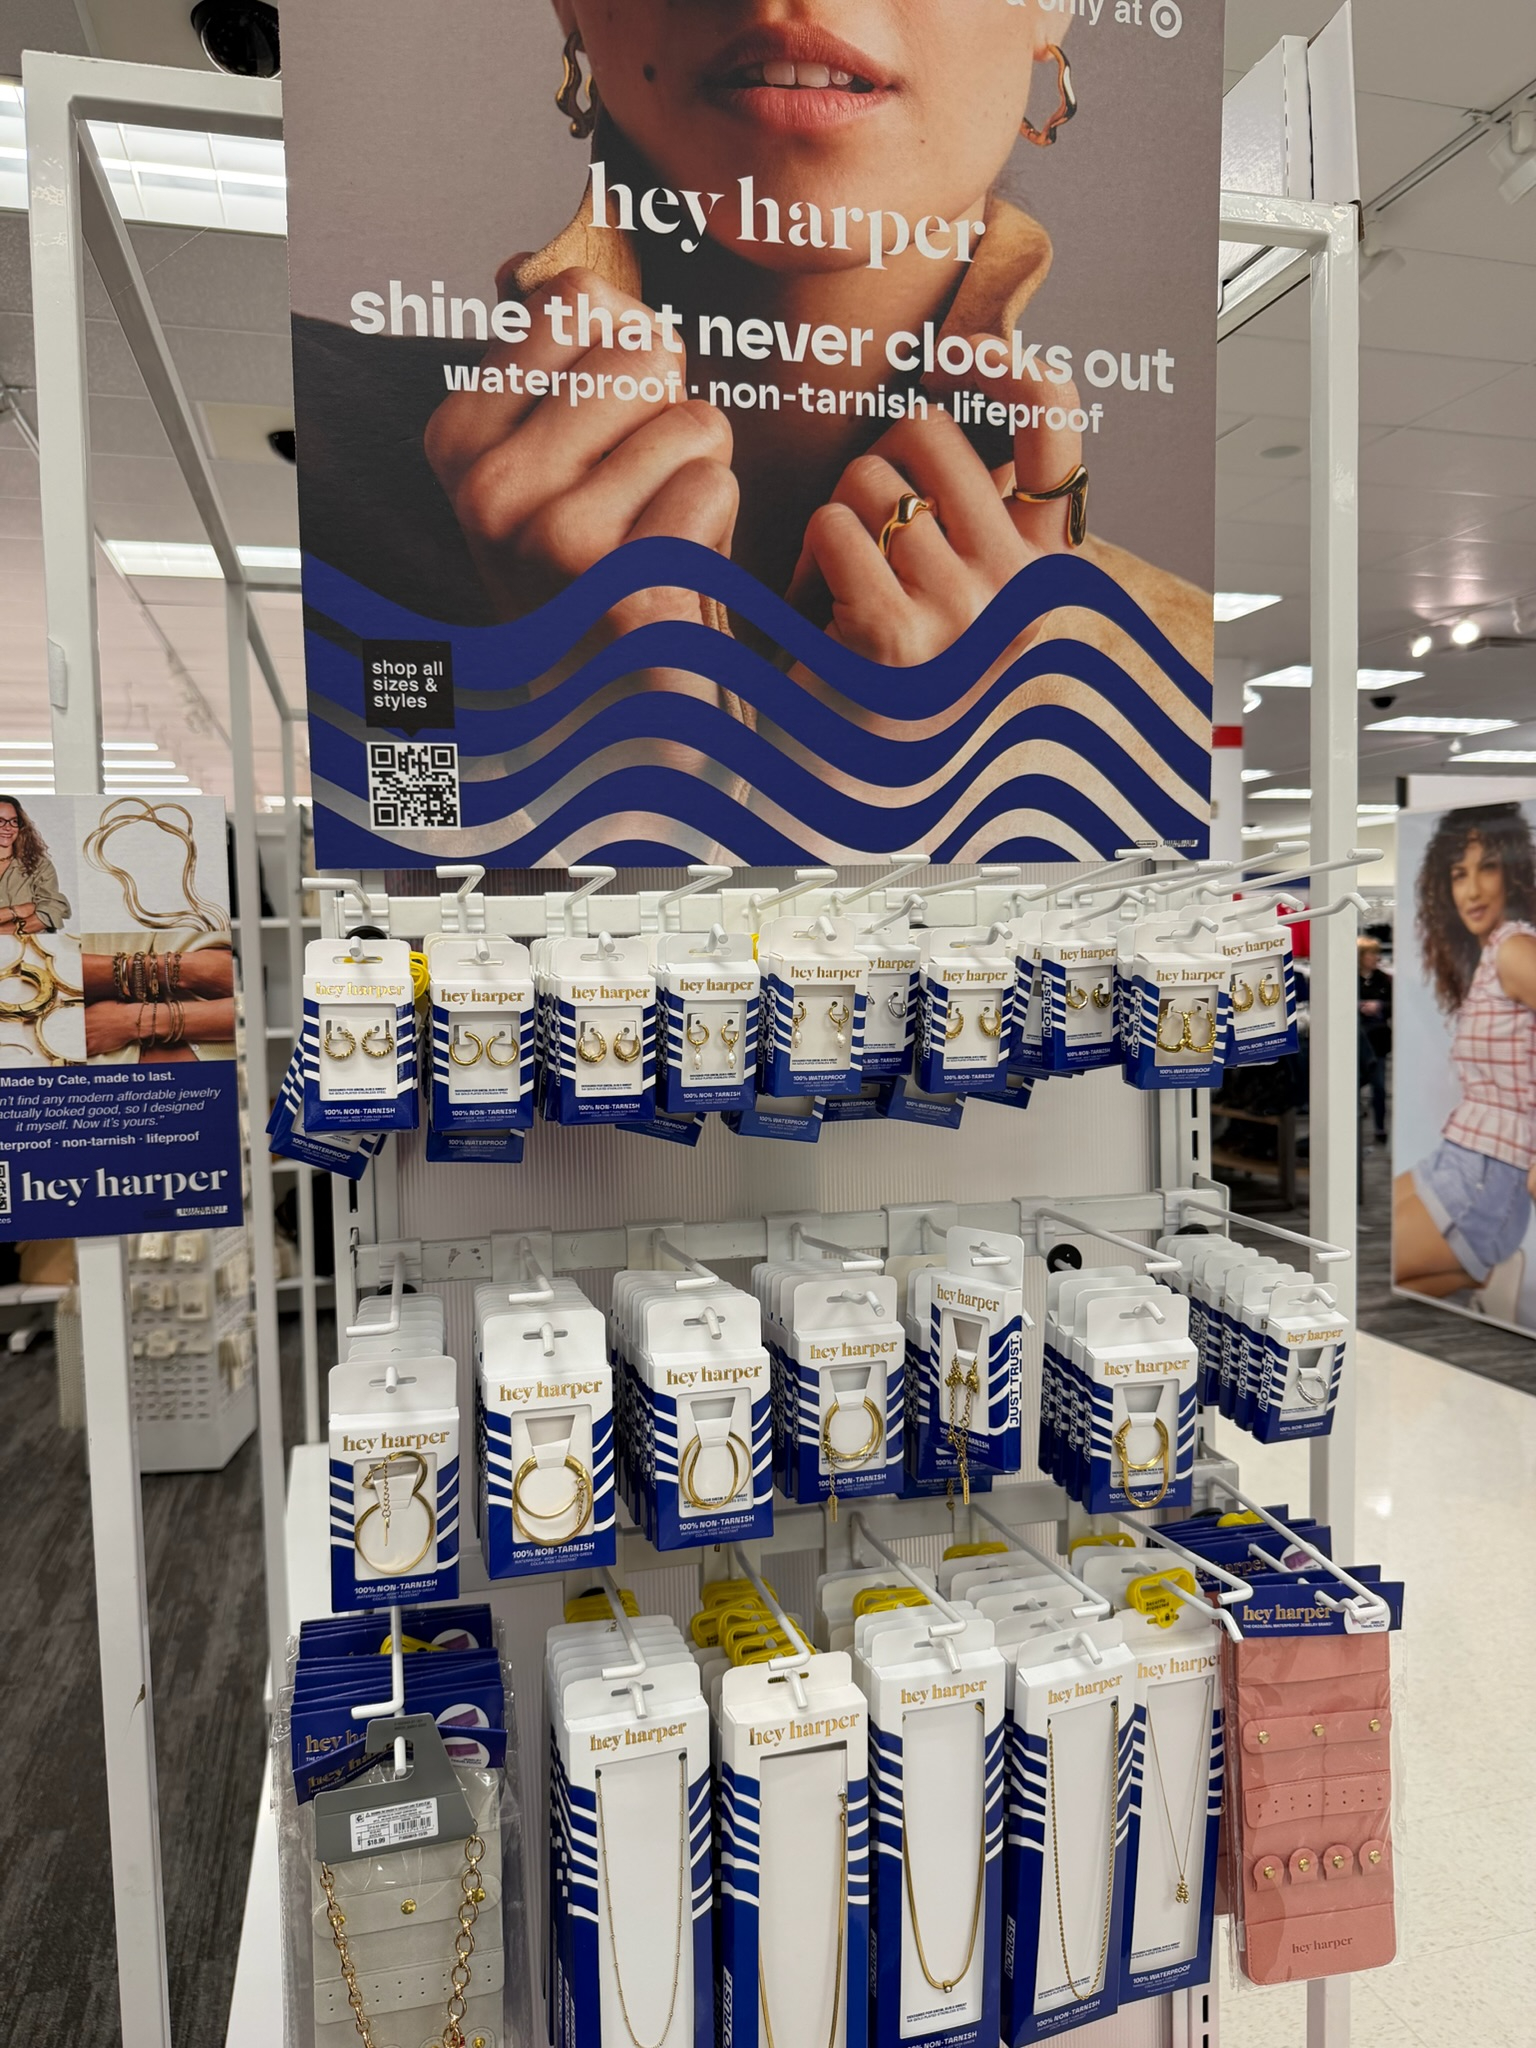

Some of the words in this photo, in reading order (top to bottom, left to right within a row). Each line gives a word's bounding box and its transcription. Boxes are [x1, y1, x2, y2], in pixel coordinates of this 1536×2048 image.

[1114, 0, 1142, 26] at
[588, 161, 724, 253] hey
[737, 175, 986, 271] harper
[350, 280, 532, 344] shine
[544, 293, 683, 354] that
[699, 313, 874, 368] never
[885, 320, 1073, 385] clocks
[1083, 346, 1175, 394] out
[443, 362, 682, 407] waterproof
[710, 379, 928, 421] non-tarnish
[953, 390, 1104, 436] lifeproof
[372, 660, 417, 678] shop
[423, 661, 443, 676] all
[373, 677, 419, 692] sizes
[425, 677, 438, 692] &
[374, 693, 428, 711] styles
[1059, 949, 1079, 962] hey
[1080, 947, 1116, 960] harper
[1222, 945, 1244, 957] hey
[1245, 938, 1286, 952] harper
[791, 966, 814, 981] hey
[816, 966, 862, 981] harper
[877, 957, 916, 972] harper
[679, 978, 705, 994] hey
[706, 978, 754, 994] harper
[942, 969, 965, 984] hey
[966, 969, 1008, 984] harper
[1155, 970, 1179, 984] hey
[1181, 969, 1225, 983] harper
[315, 982, 345, 998] hey
[347, 982, 405, 998] harper
[441, 988, 470, 1005] hey
[471, 988, 525, 1005] harper
[571, 985, 598, 1001] hey
[600, 985, 650, 1001] harper
[1044, 1016, 1051, 1036] NO
[0, 1076, 35, 1087] Made
[38, 1076, 54, 1088] by
[58, 1074, 91, 1086] Cate,
[94, 1073, 129, 1084] made
[132, 1072, 146, 1082] to
[149, 1071, 175, 1081] last.
[17, 1094, 40, 1105] find
[42, 1096, 65, 1106] any
[68, 1092, 114, 1103] modern
[117, 1089, 176, 1101] affordable
[178, 1088, 221, 1101] jewelry
[45, 1105, 86, 1117] looked
[125, 1105, 140, 1114] so
[150, 1100, 205, 1114] designed
[26, 1120, 69, 1133] myself.
[73, 1119, 101, 1129] Now
[62, 1134, 136, 1149] non-tarnish
[146, 1131, 200, 1144] lifeproof
[21, 1171, 90, 1207] hey
[96, 1168, 229, 1201] harper
[937, 1284, 956, 1305] hey
[957, 1288, 1000, 1312] harper
[810, 1344, 839, 1362] hey
[841, 1341, 898, 1358] harper
[1010, 1334, 1020, 1386] TRUST.
[666, 1368, 699, 1388] hey
[701, 1365, 763, 1384] harper
[1104, 1361, 1133, 1378] hey
[1135, 1359, 1190, 1375] harper
[499, 1383, 534, 1404] hey
[537, 1380, 603, 1400] harper
[1238, 1380, 1246, 1399] NO
[1010, 1388, 1019, 1425] JUST
[1259, 1392, 1268, 1412] NO
[342, 1435, 379, 1454] hey
[381, 1431, 450, 1450] harper
[836, 1473, 887, 1486] NON-TARNISH
[679, 1522, 699, 1531] 100%
[699, 1514, 755, 1529] NON-TARNISH
[512, 1550, 534, 1558] 100%
[535, 1542, 595, 1557] NON-TARNISH
[354, 1586, 376, 1595] 100%
[377, 1579, 438, 1593] NON-TARNISH
[1243, 1605, 1274, 1624] hey
[1275, 1604, 1333, 1623] harper
[1137, 1662, 1167, 1680] hey
[1169, 1654, 1221, 1674] harper
[901, 1688, 930, 1705] hey
[932, 1680, 987, 1700] harper
[1048, 1688, 1074, 1705] hey
[1075, 1675, 1123, 1698] harper
[590, 1734, 623, 1752] hey
[625, 1722, 687, 1744] harper
[749, 1727, 786, 1747] hey
[789, 1713, 860, 1740] harper
[305, 1734, 343, 1754] hey
[1292, 1943, 1312, 1954] hey
[1313, 1937, 1353, 1950] harper
[1149, 1964, 1191, 1981] WATERPROOF
[723, 1972, 732, 2033] RUST.
[1054, 2000, 1101, 2021] NON-TARNISH
